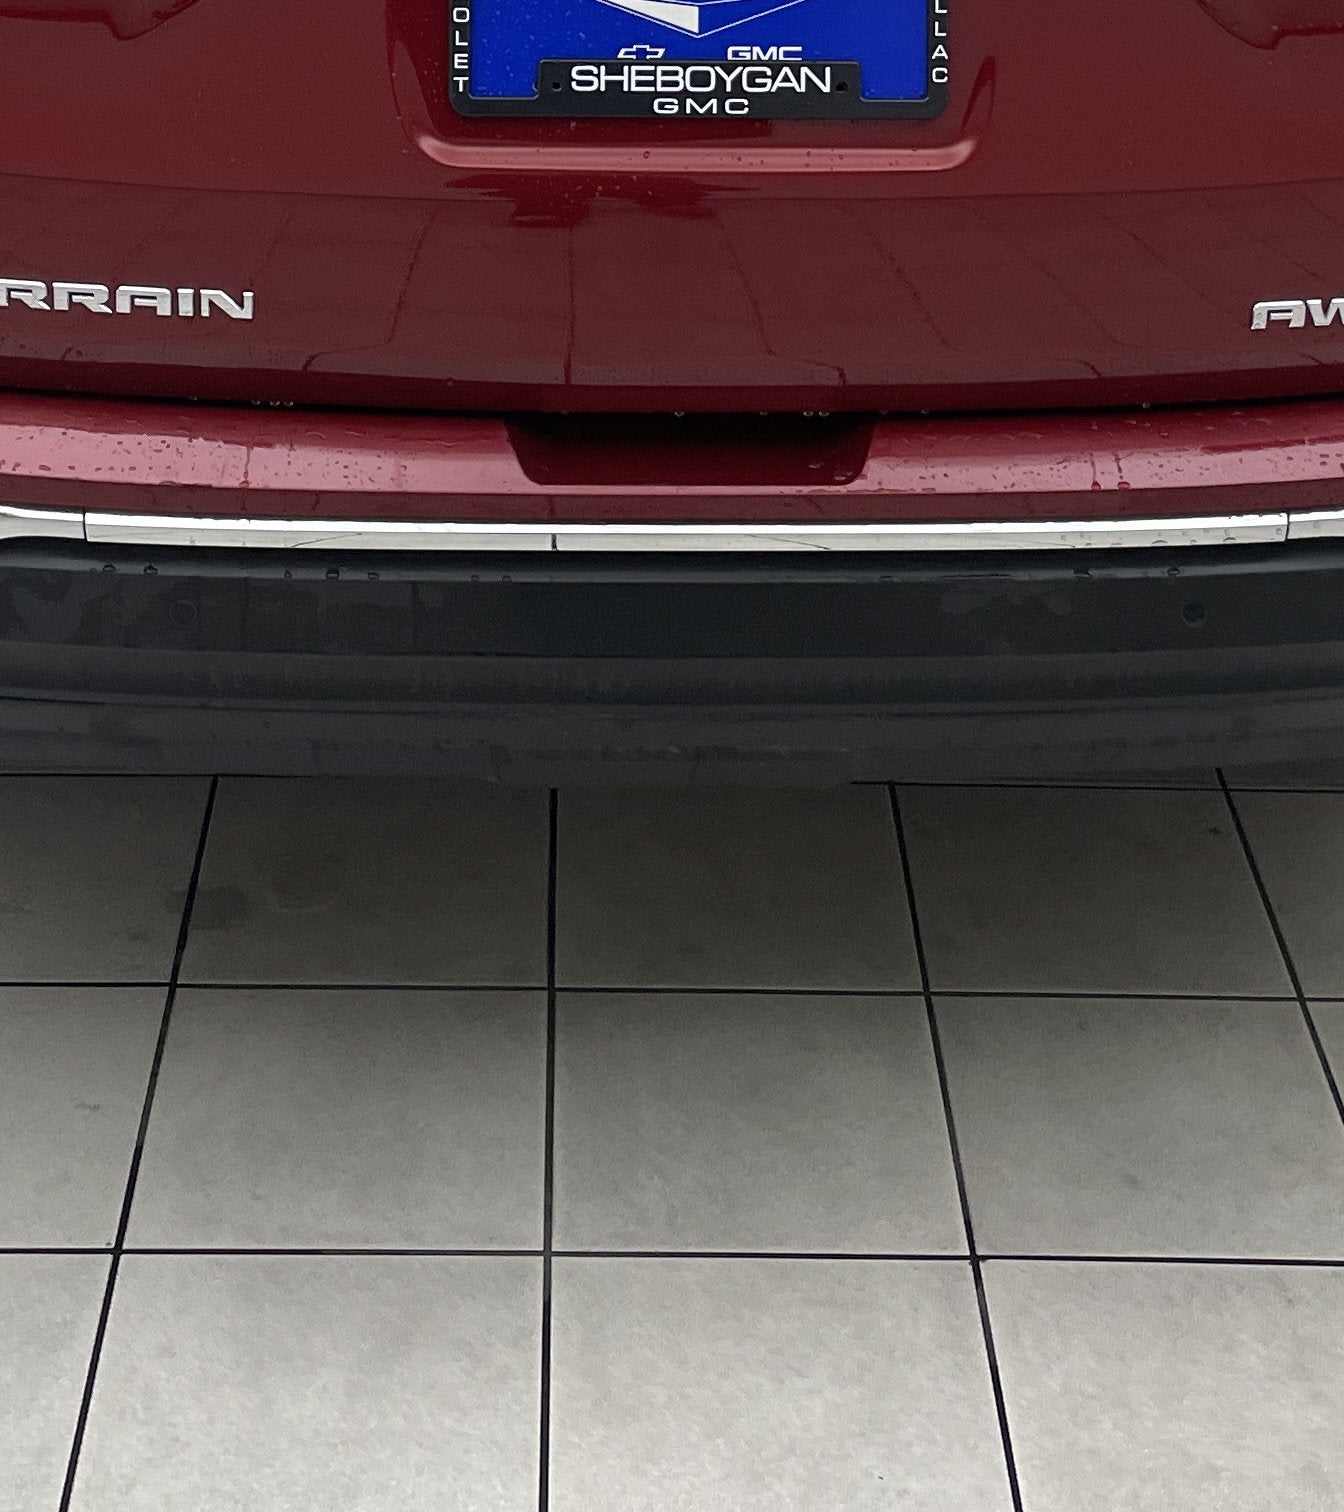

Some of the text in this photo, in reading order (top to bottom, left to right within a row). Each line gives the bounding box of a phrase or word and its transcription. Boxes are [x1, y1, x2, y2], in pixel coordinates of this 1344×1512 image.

[726, 45, 803, 62] GMC
[570, 64, 832, 93] SHEBOYGAN
[652, 97, 750, 115] GMC
